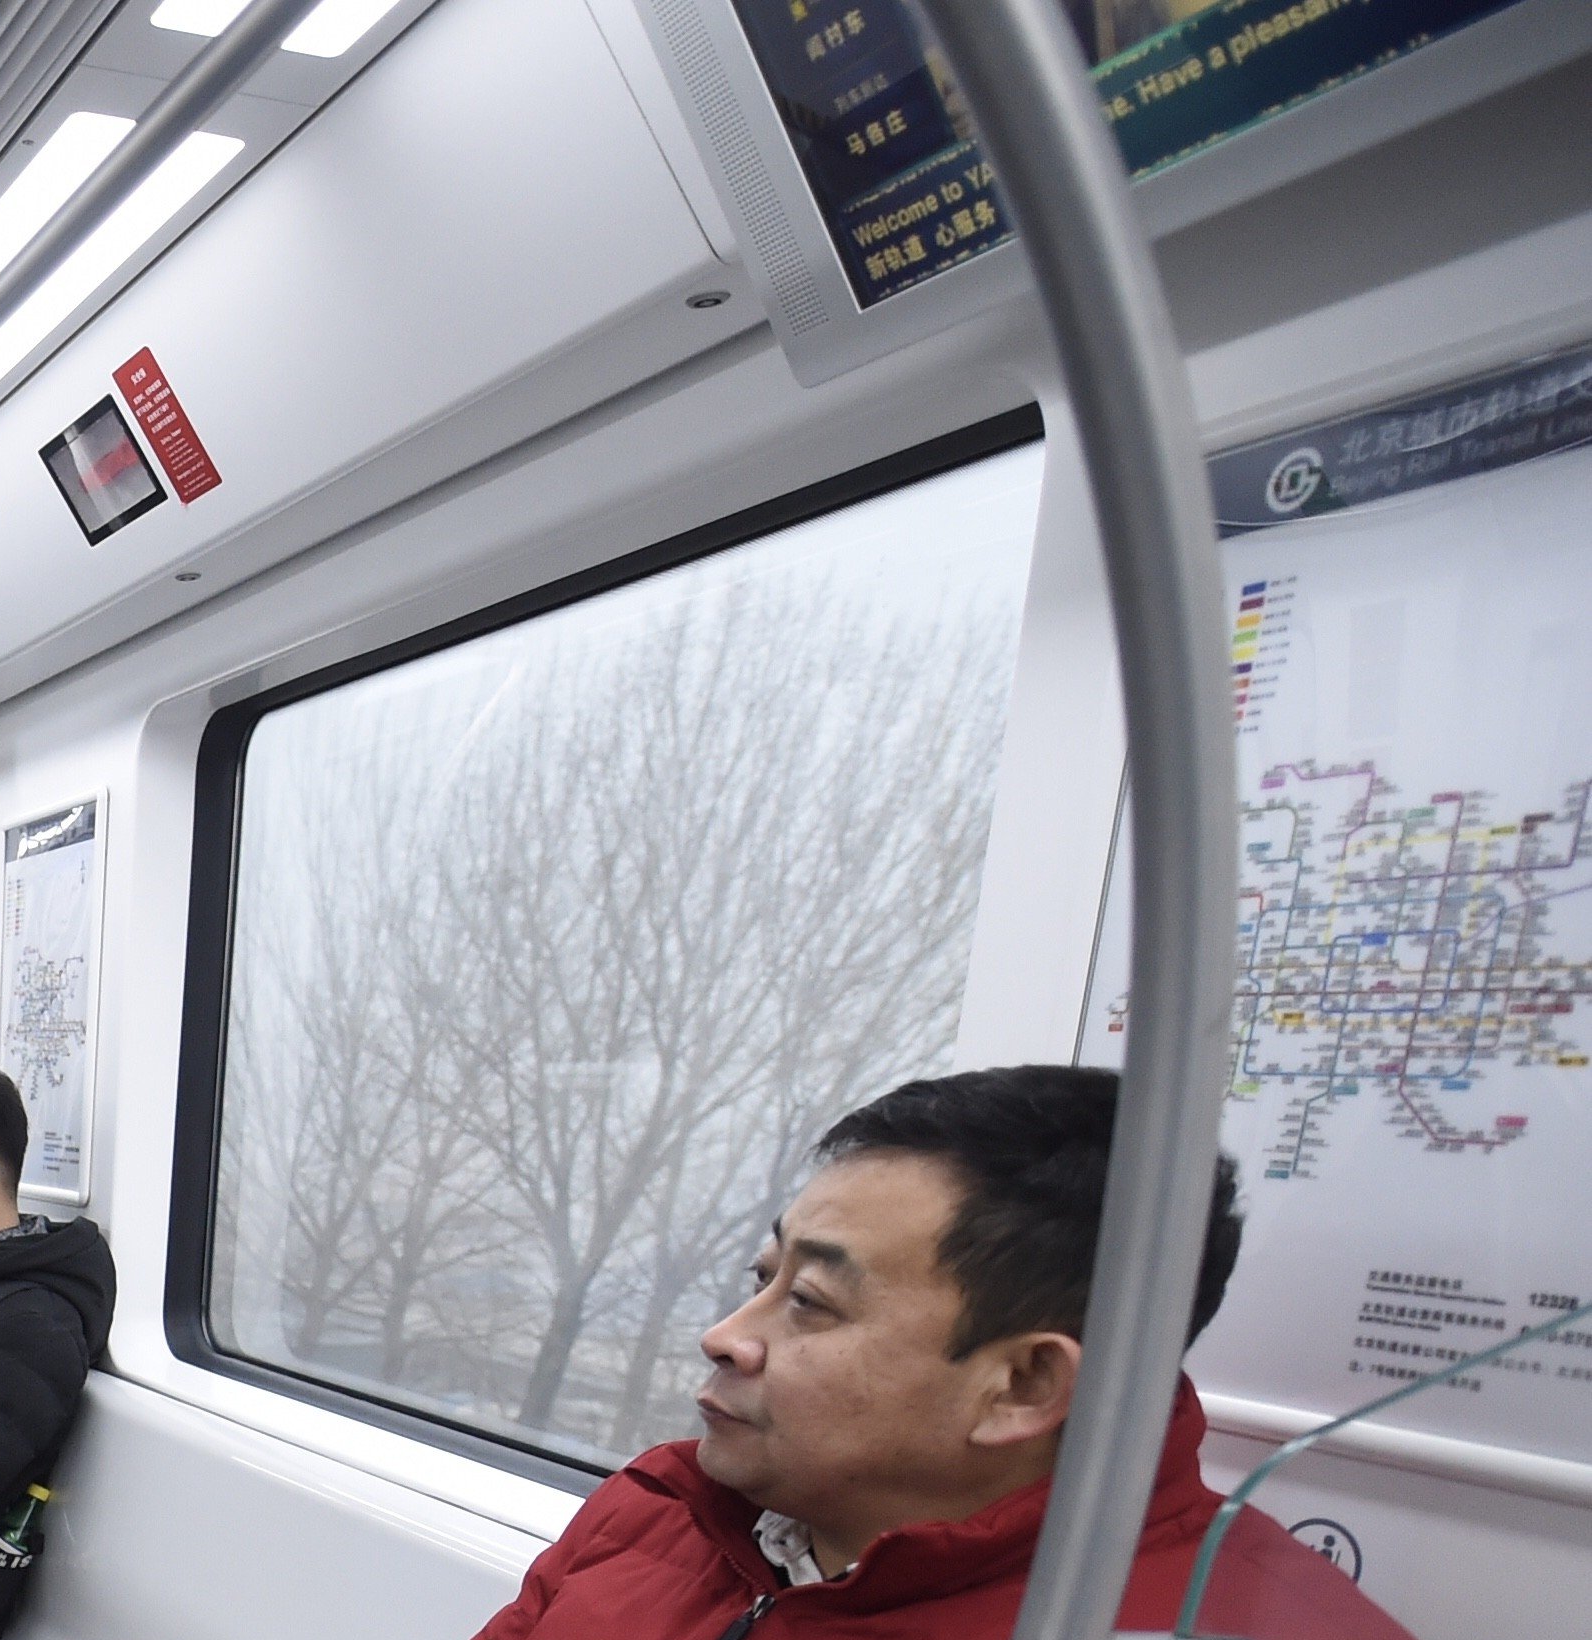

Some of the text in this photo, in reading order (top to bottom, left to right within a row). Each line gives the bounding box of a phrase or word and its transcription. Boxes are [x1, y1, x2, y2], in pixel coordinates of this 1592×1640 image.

[852, 194, 939, 248] Welcome
[940, 181, 964, 204] to
[1135, 57, 1204, 104] Have
[1208, 44, 1227, 70] a
